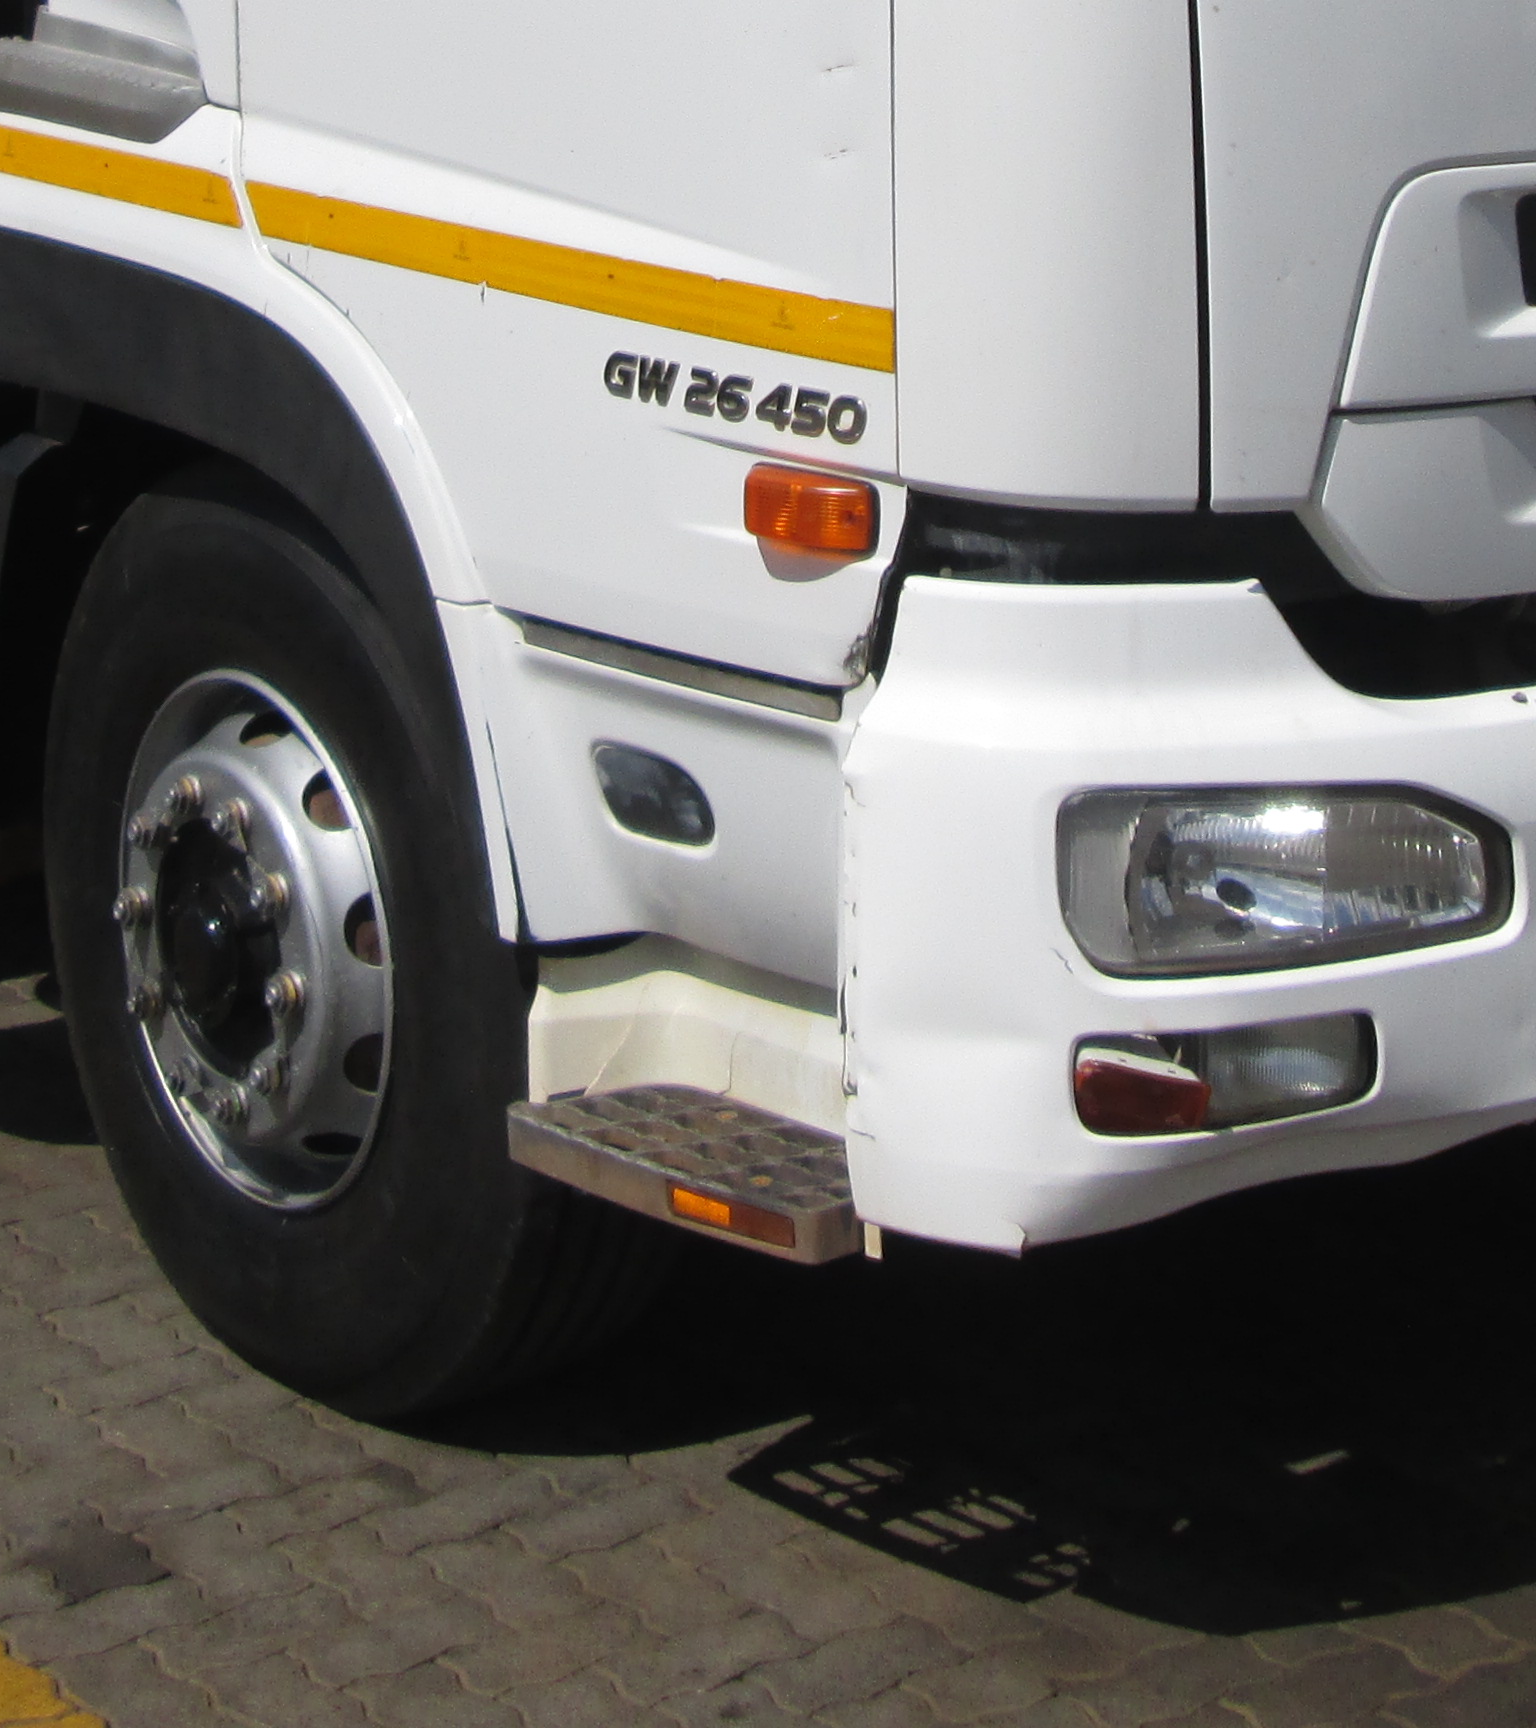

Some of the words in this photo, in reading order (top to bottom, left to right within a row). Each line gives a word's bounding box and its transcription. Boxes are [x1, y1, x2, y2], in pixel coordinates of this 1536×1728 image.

[603, 350, 681, 408] GW
[683, 365, 754, 423] 26
[755, 382, 868, 445] 450
